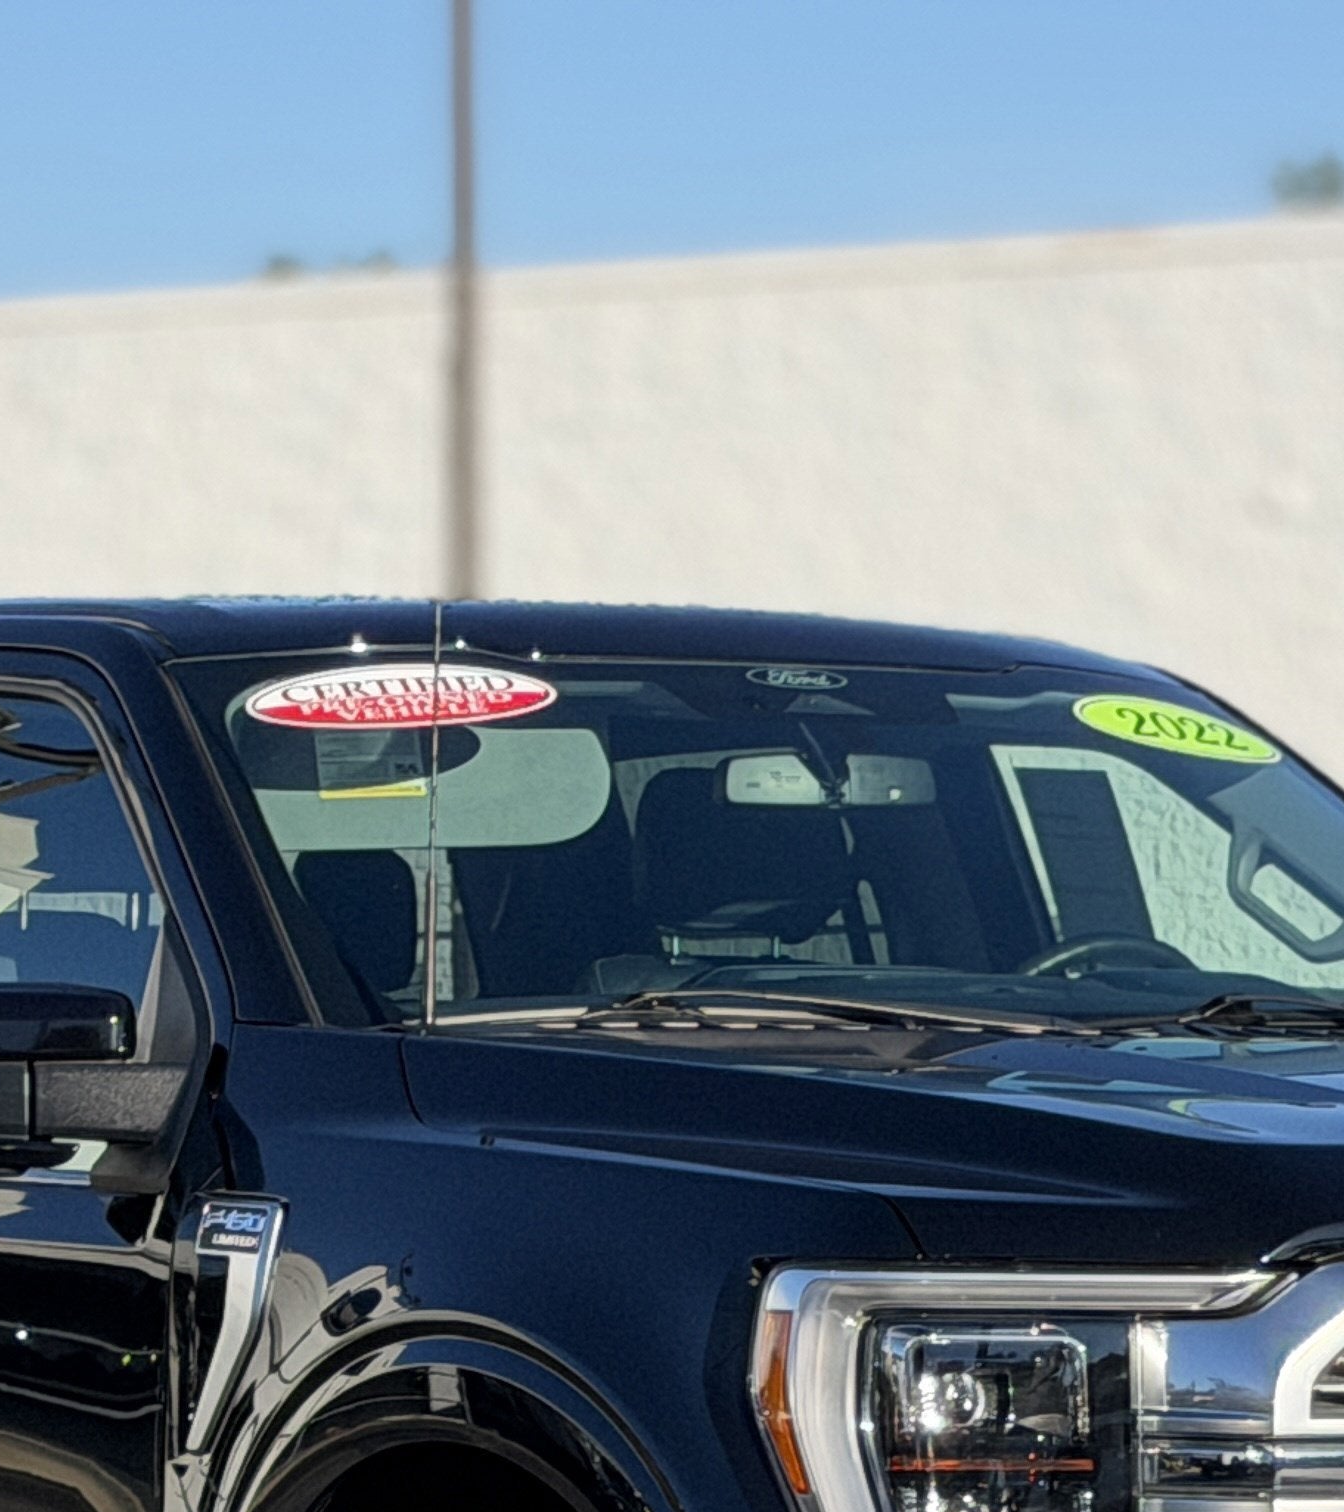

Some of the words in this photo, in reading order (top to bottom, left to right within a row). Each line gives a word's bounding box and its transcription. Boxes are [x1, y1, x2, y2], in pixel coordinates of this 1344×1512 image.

[282, 675, 514, 703] CERTIFIED
[767, 669, 831, 686] Ford
[338, 699, 490, 721] VEHICLE
[1115, 707, 1249, 751] 2022
